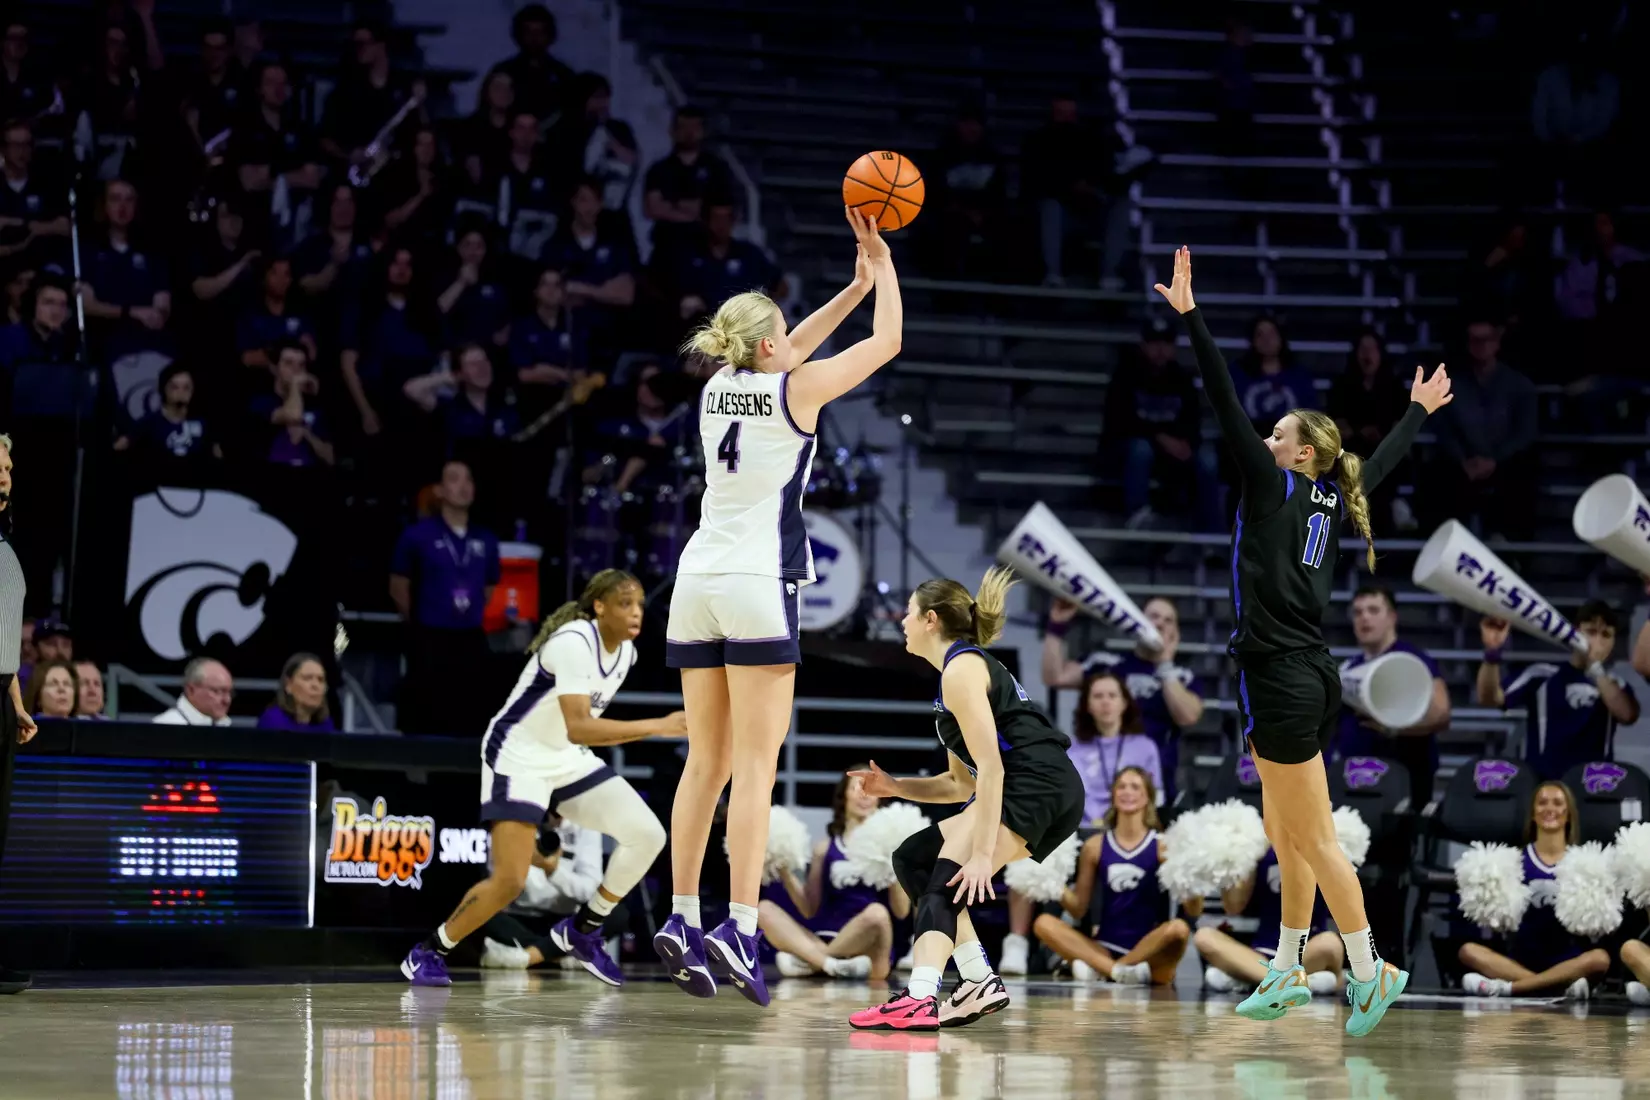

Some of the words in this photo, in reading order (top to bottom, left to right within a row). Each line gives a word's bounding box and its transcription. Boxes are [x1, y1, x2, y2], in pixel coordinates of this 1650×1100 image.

[706, 392, 772, 416] CLAESSENS
[717, 420, 742, 473] 4
[1302, 512, 1330, 569] 11
[329, 800, 433, 881] Briggs
[439, 828, 487, 864] SINCE
